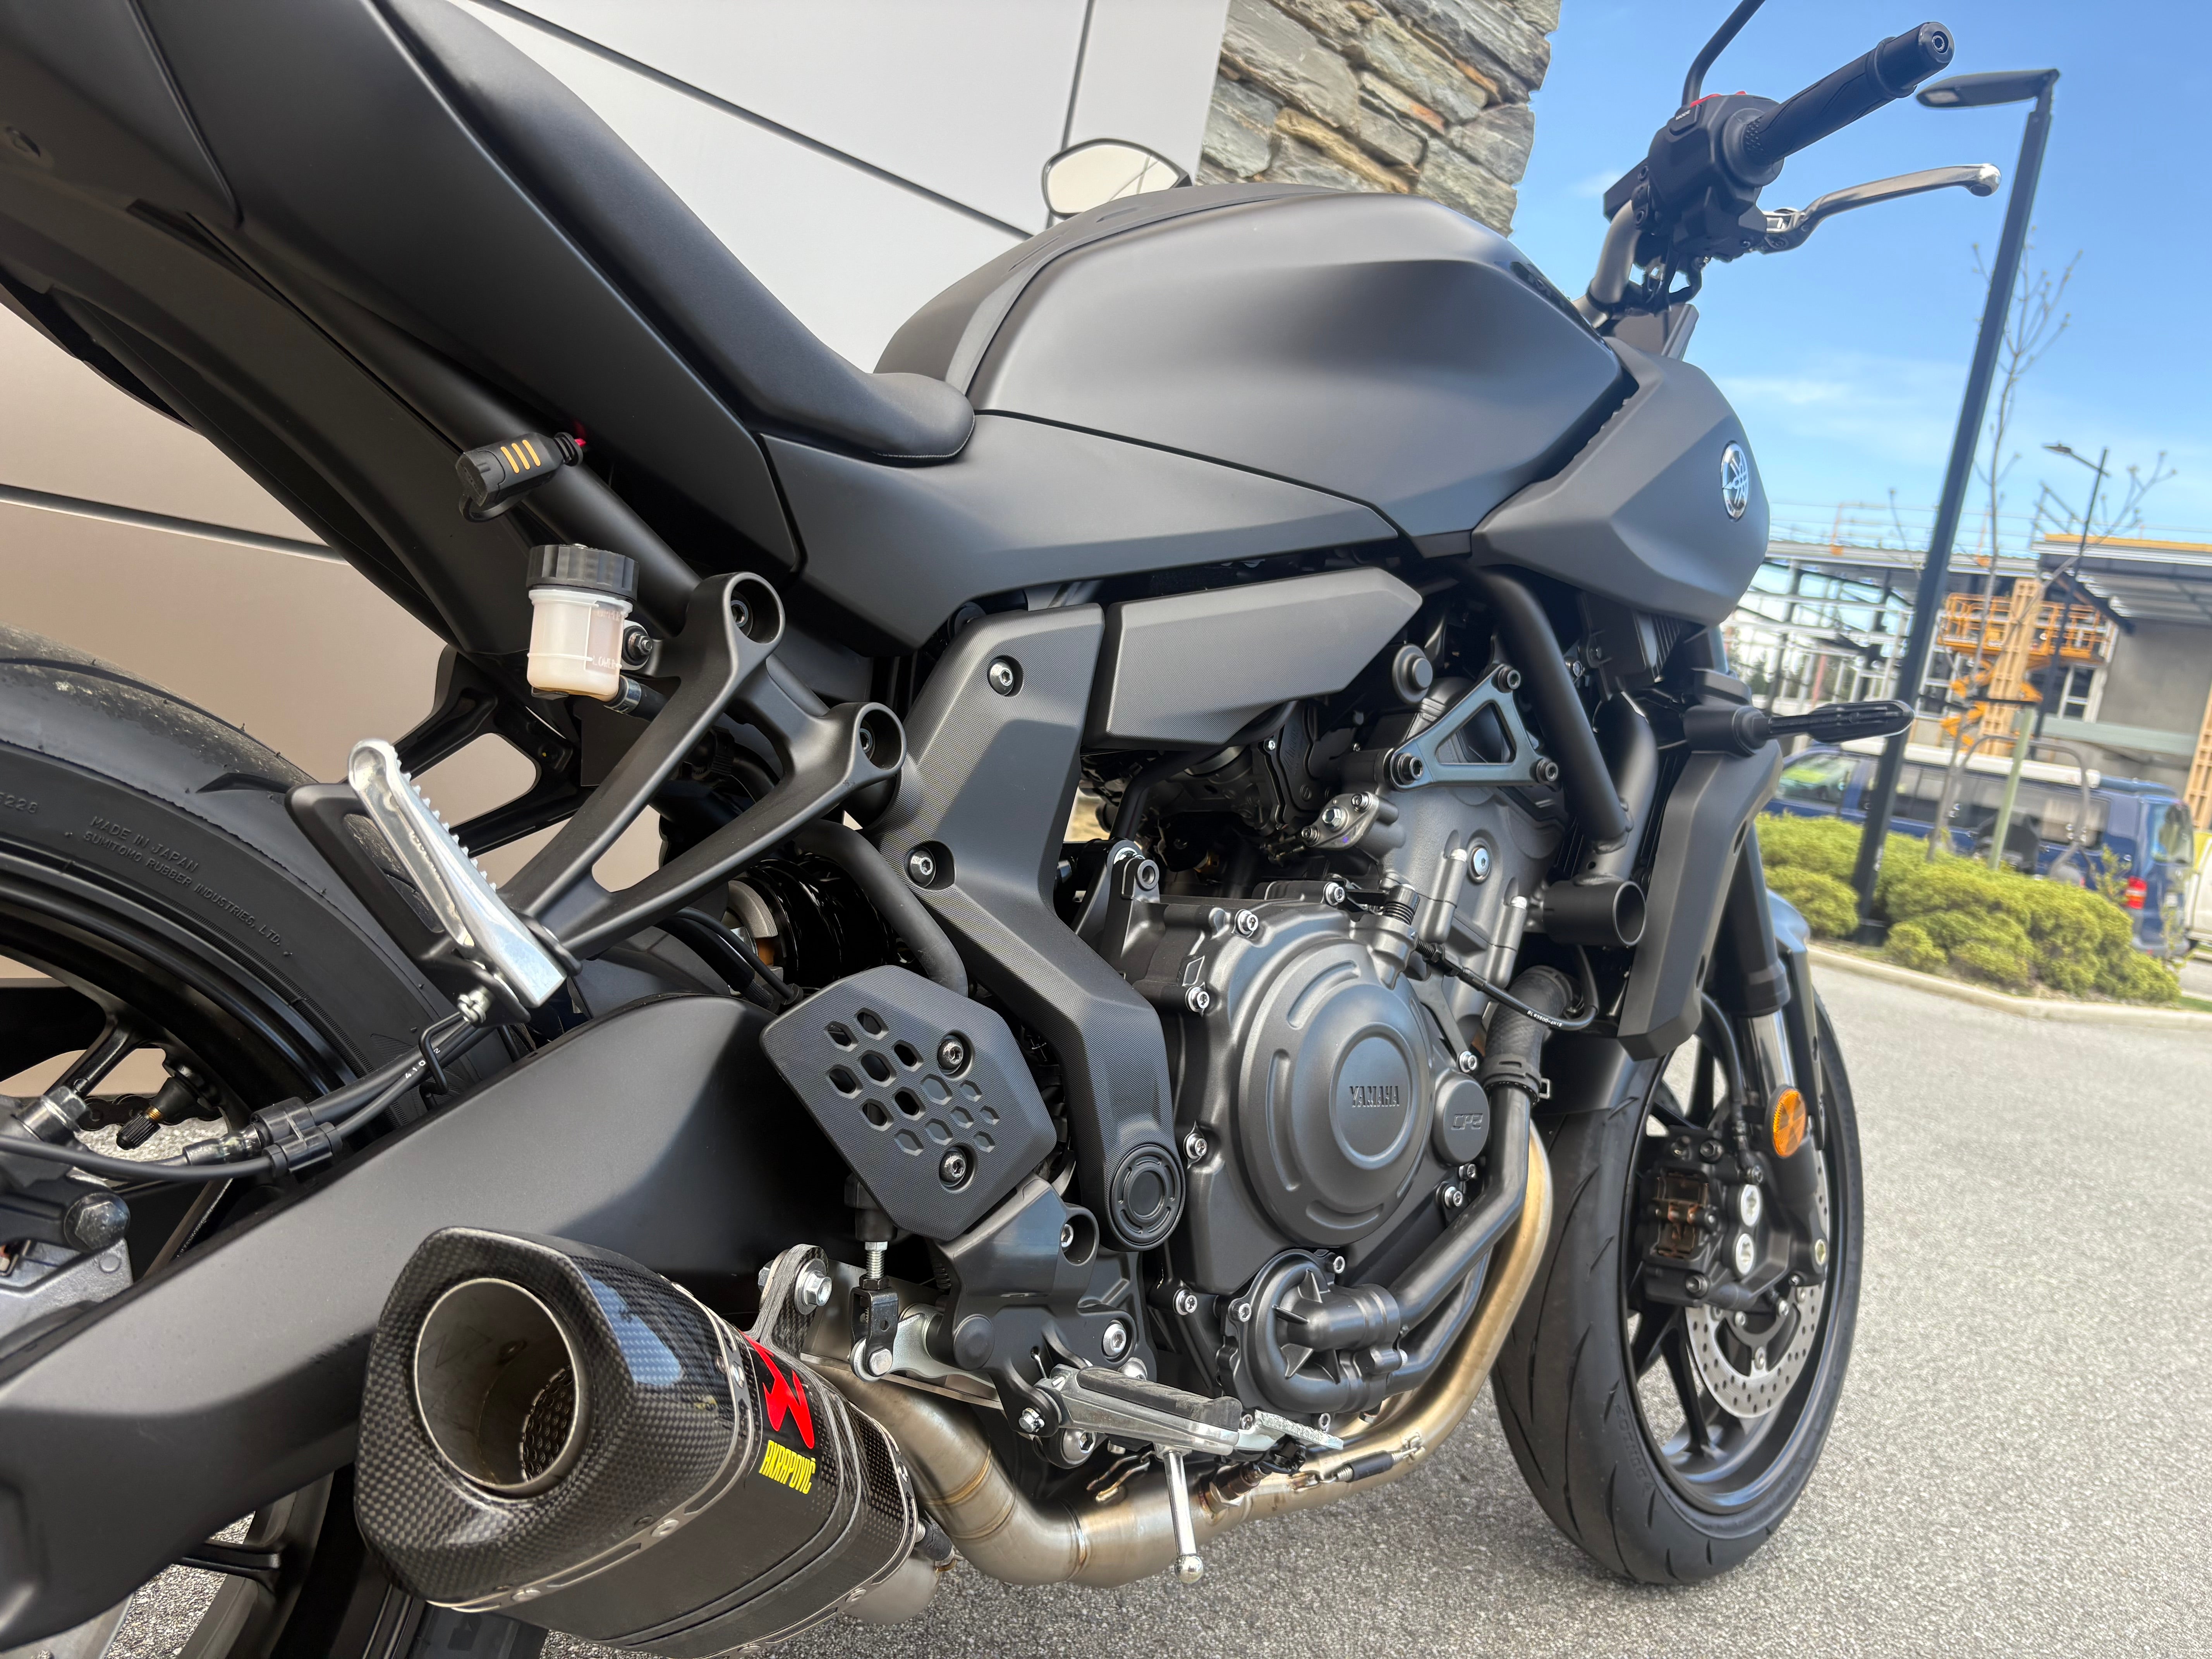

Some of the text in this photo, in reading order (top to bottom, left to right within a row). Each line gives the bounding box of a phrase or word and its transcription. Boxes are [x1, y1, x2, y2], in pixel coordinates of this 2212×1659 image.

[89, 816, 199, 872] MADE IN JAPAN
[83, 831, 281, 946] SUMITOMO RUBBER INDUSTRIES, LTD.
[1349, 1085, 1400, 1108] YAMAHA
[1451, 1113, 1483, 1130] CP2
